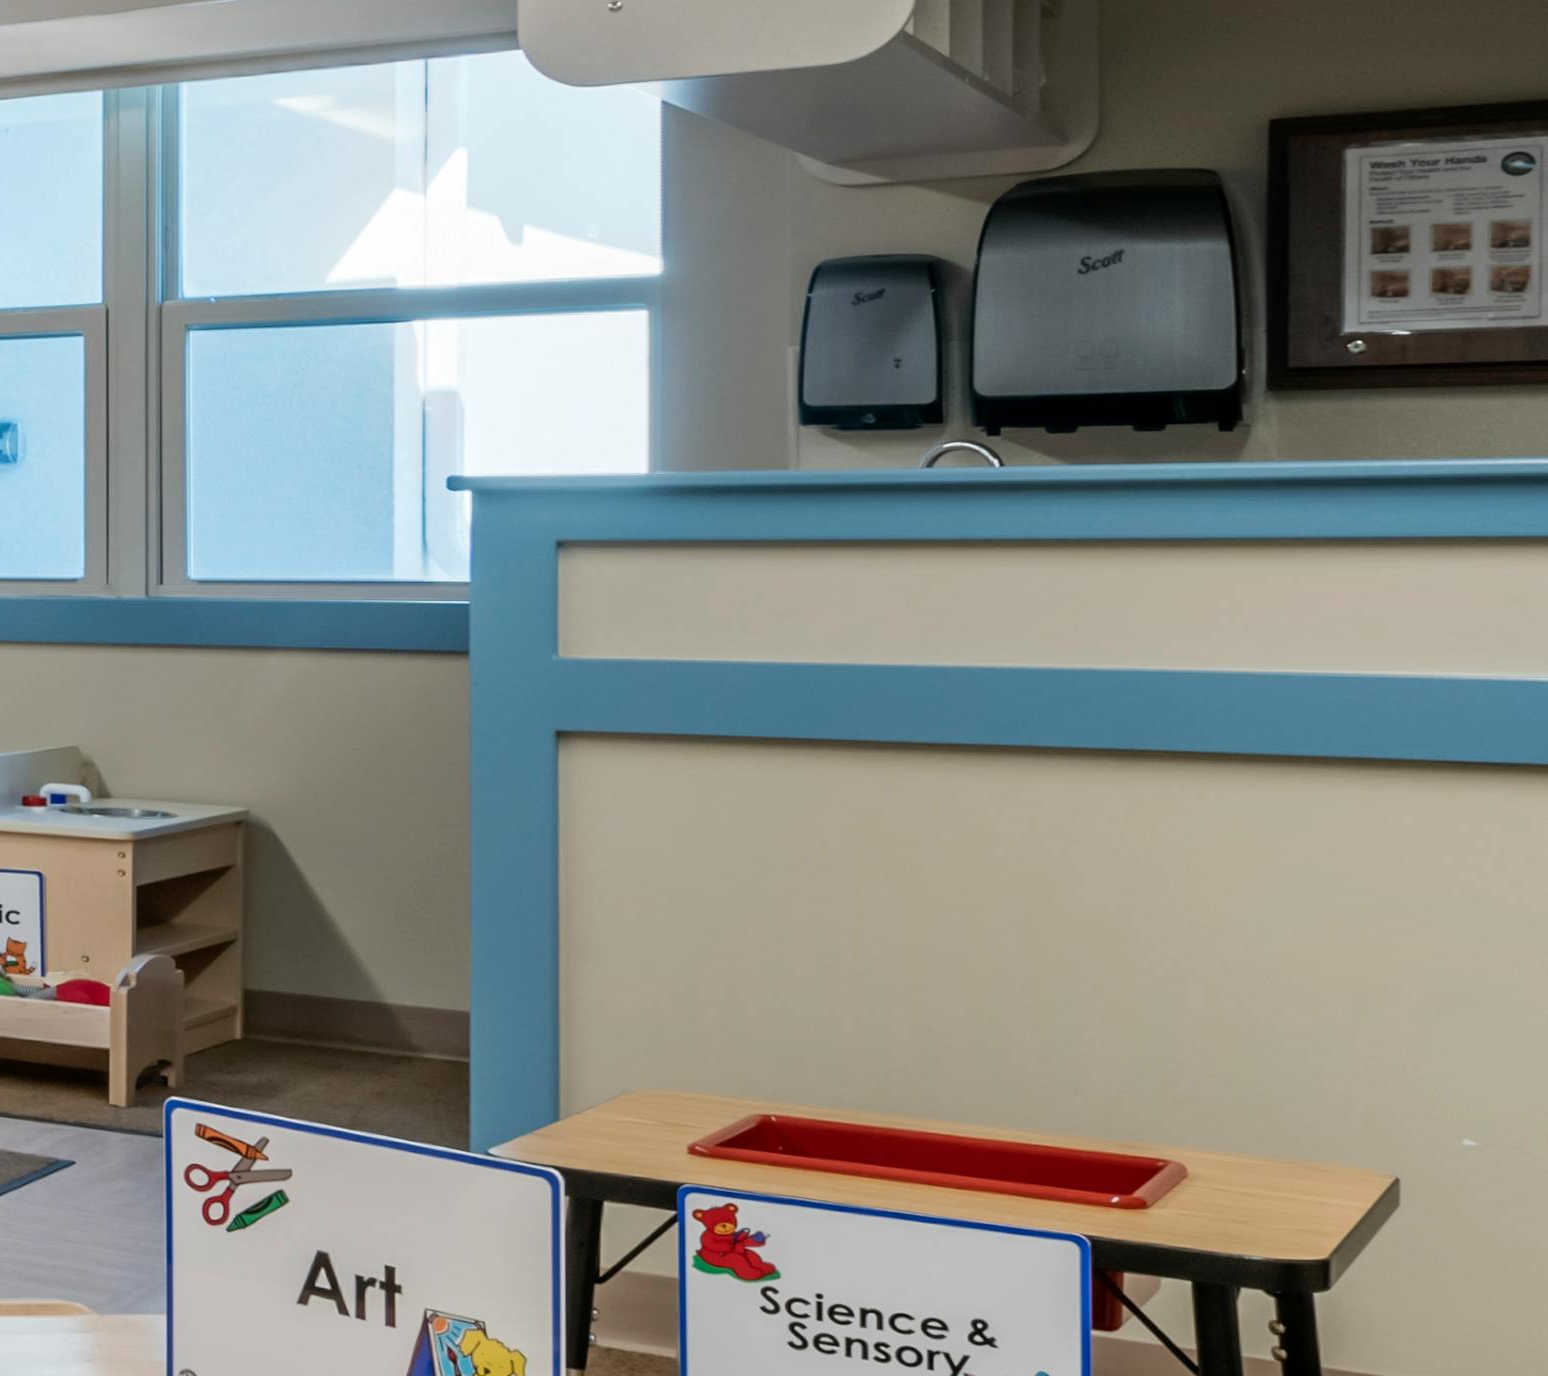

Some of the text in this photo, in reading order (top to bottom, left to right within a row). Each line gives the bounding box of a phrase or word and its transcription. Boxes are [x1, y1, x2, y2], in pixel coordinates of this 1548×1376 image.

[1369, 155, 1488, 170] Wash Your Hands
[1078, 248, 1125, 275] Scott
[852, 288, 886, 306] Scott
[297, 1249, 403, 1328] Art
[759, 1286, 999, 1349] Science &
